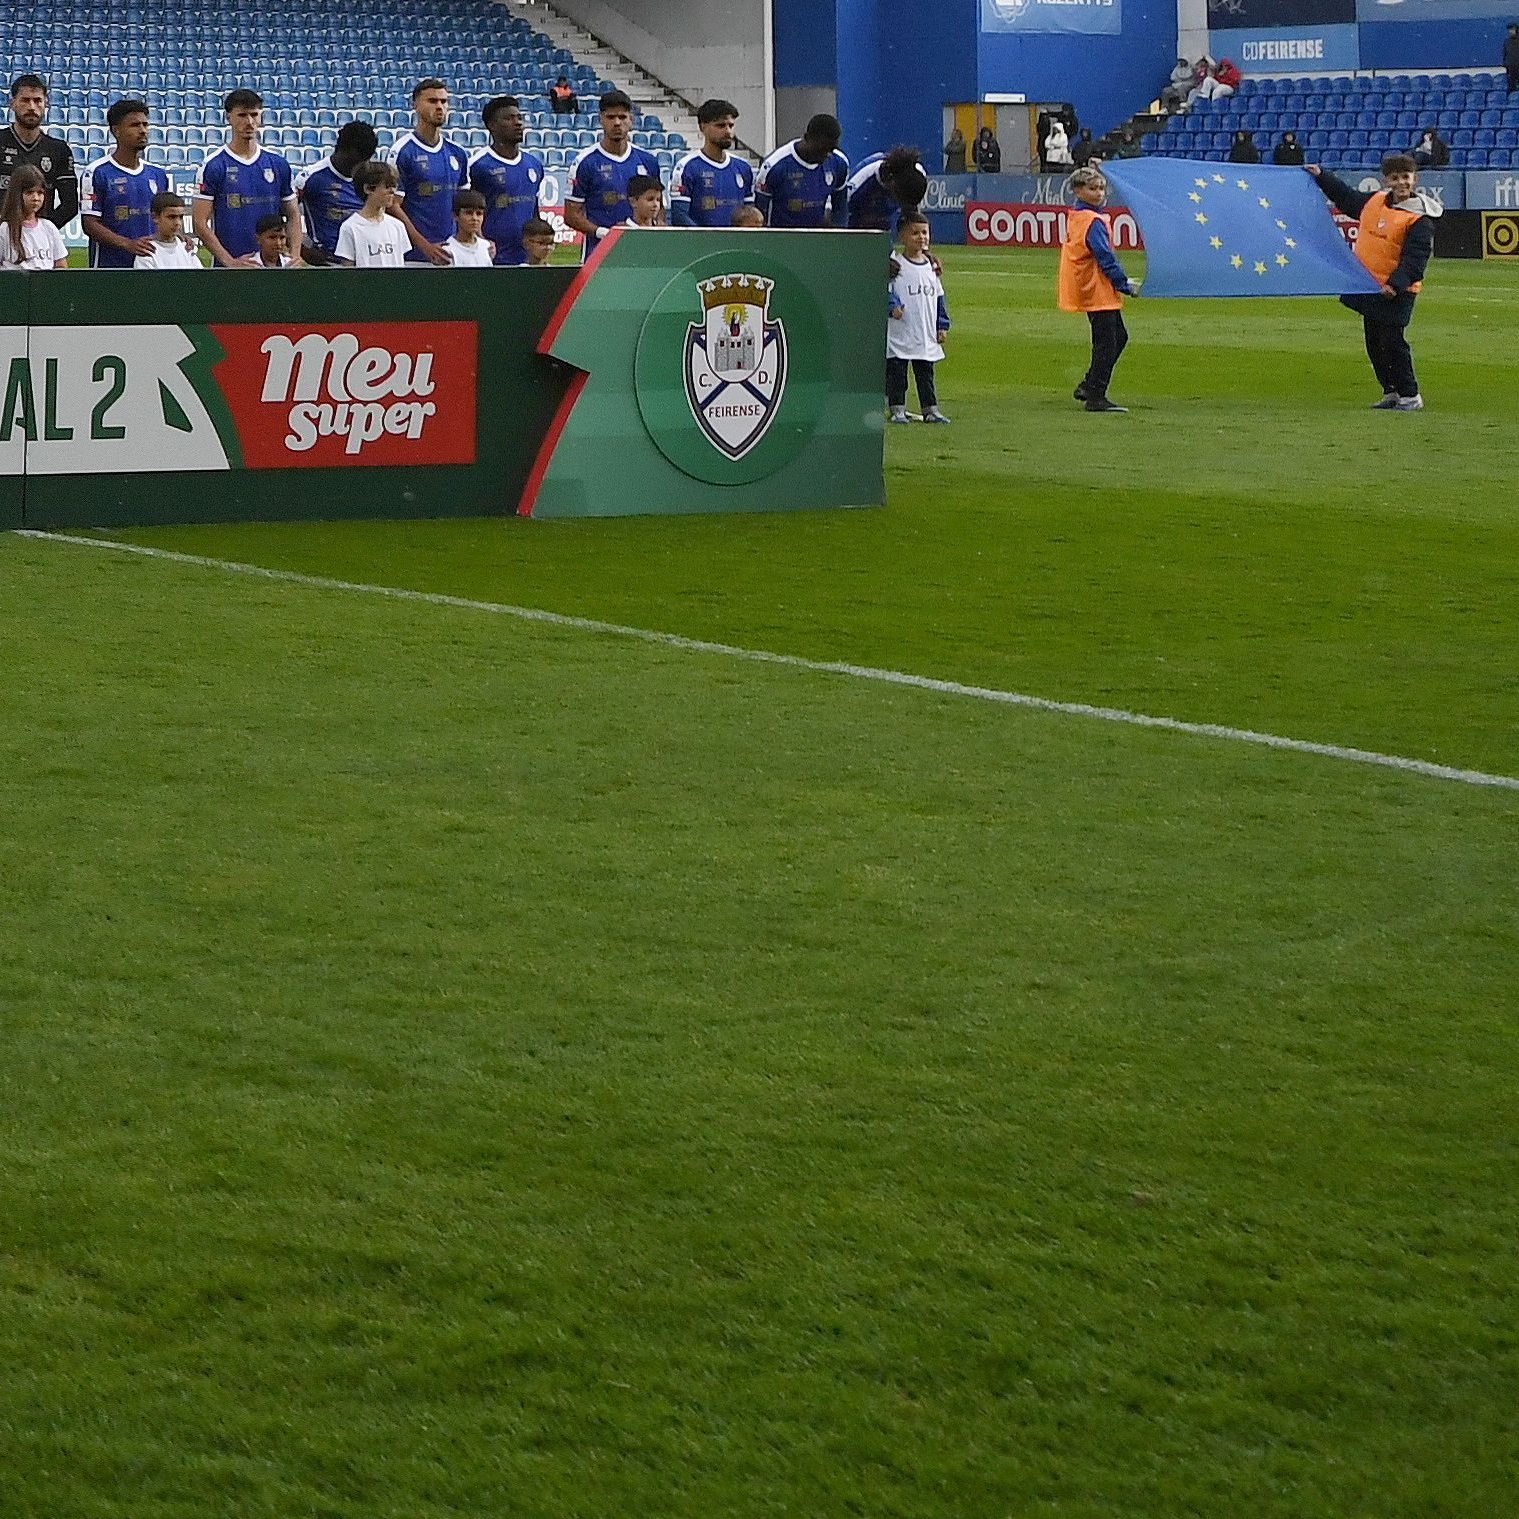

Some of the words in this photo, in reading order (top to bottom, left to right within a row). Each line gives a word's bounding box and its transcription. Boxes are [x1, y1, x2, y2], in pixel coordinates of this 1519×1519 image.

[91, 355, 127, 440] 2
[260, 333, 436, 402] Meu
[284, 401, 437, 455] super
[708, 404, 761, 419] FEIRENSE
